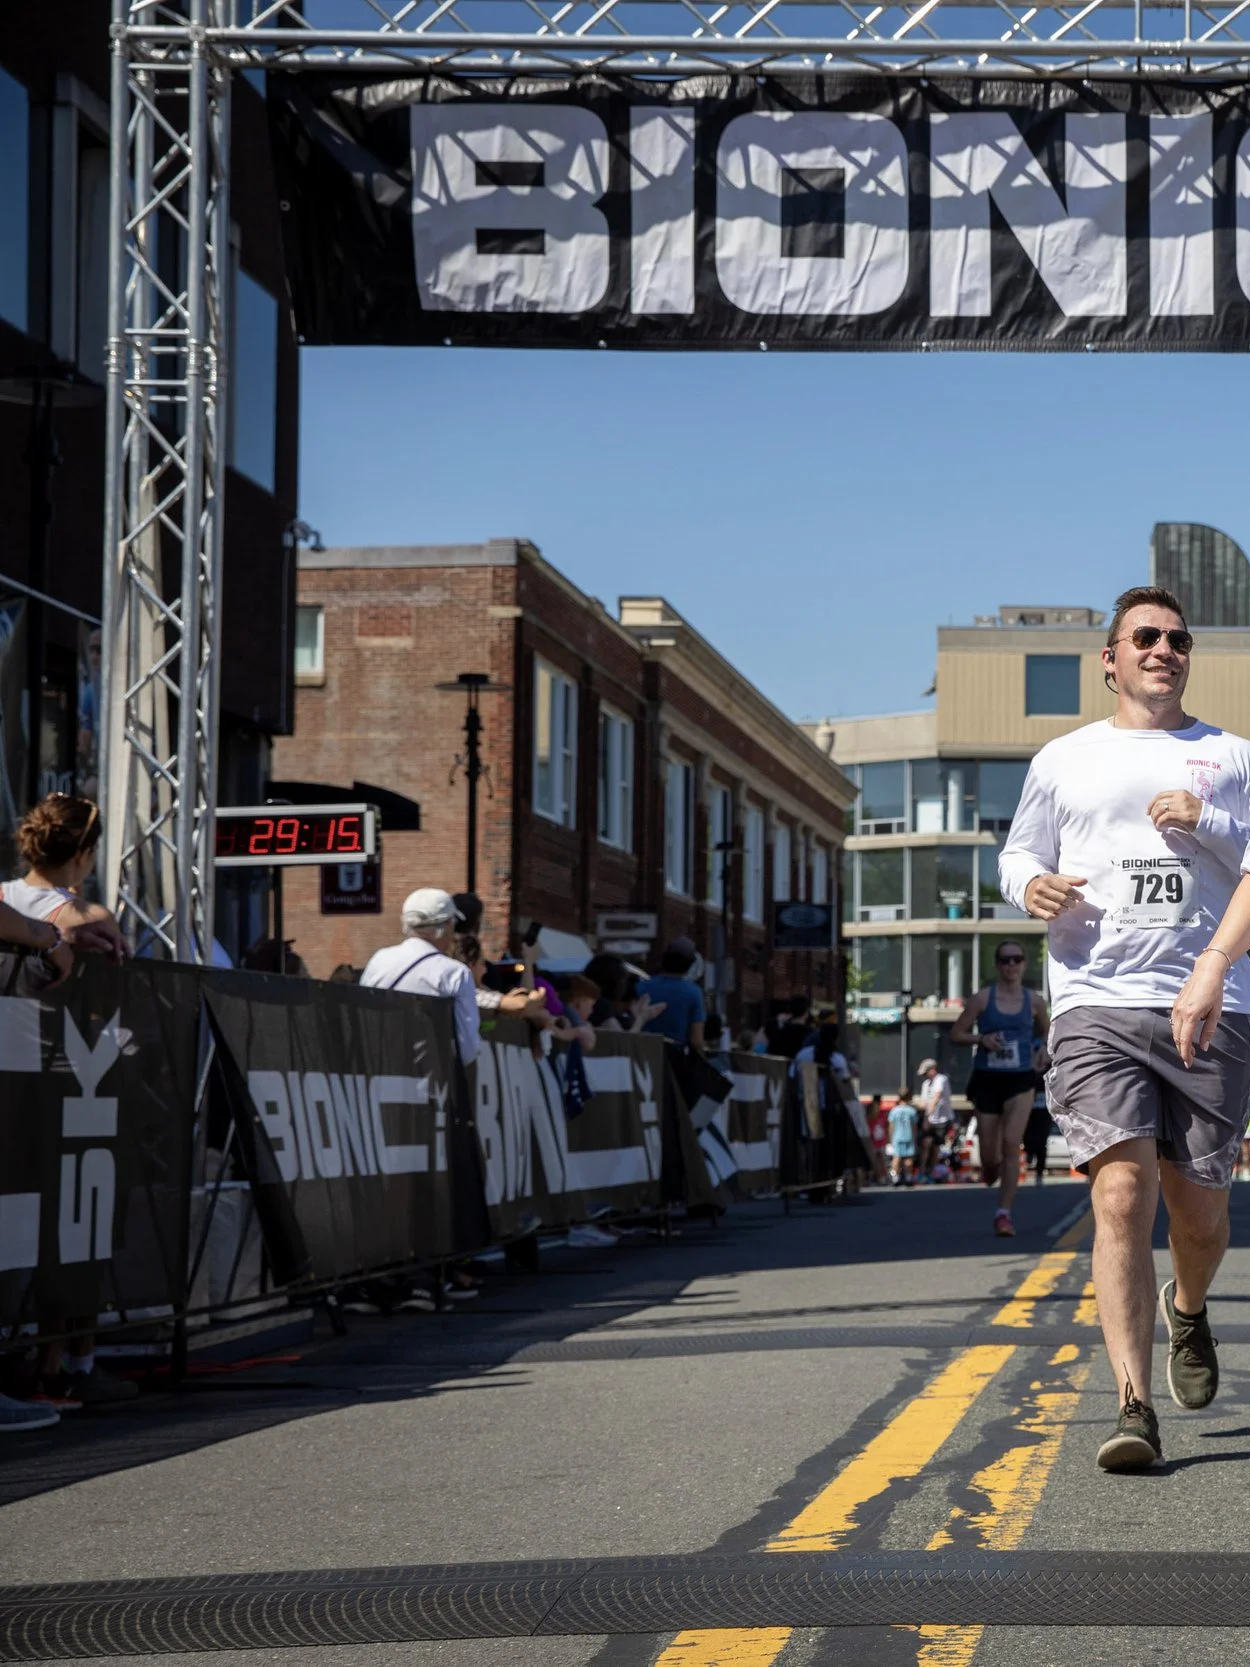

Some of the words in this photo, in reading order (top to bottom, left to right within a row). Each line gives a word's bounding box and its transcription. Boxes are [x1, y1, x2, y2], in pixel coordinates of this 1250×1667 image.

[1186, 759, 1211, 768] BIONIC
[1122, 857, 1180, 868] BIONIC
[1130, 873, 1184, 905] 729
[59, 1005, 121, 1265] 5K
[247, 1070, 429, 1182] BIONIC
